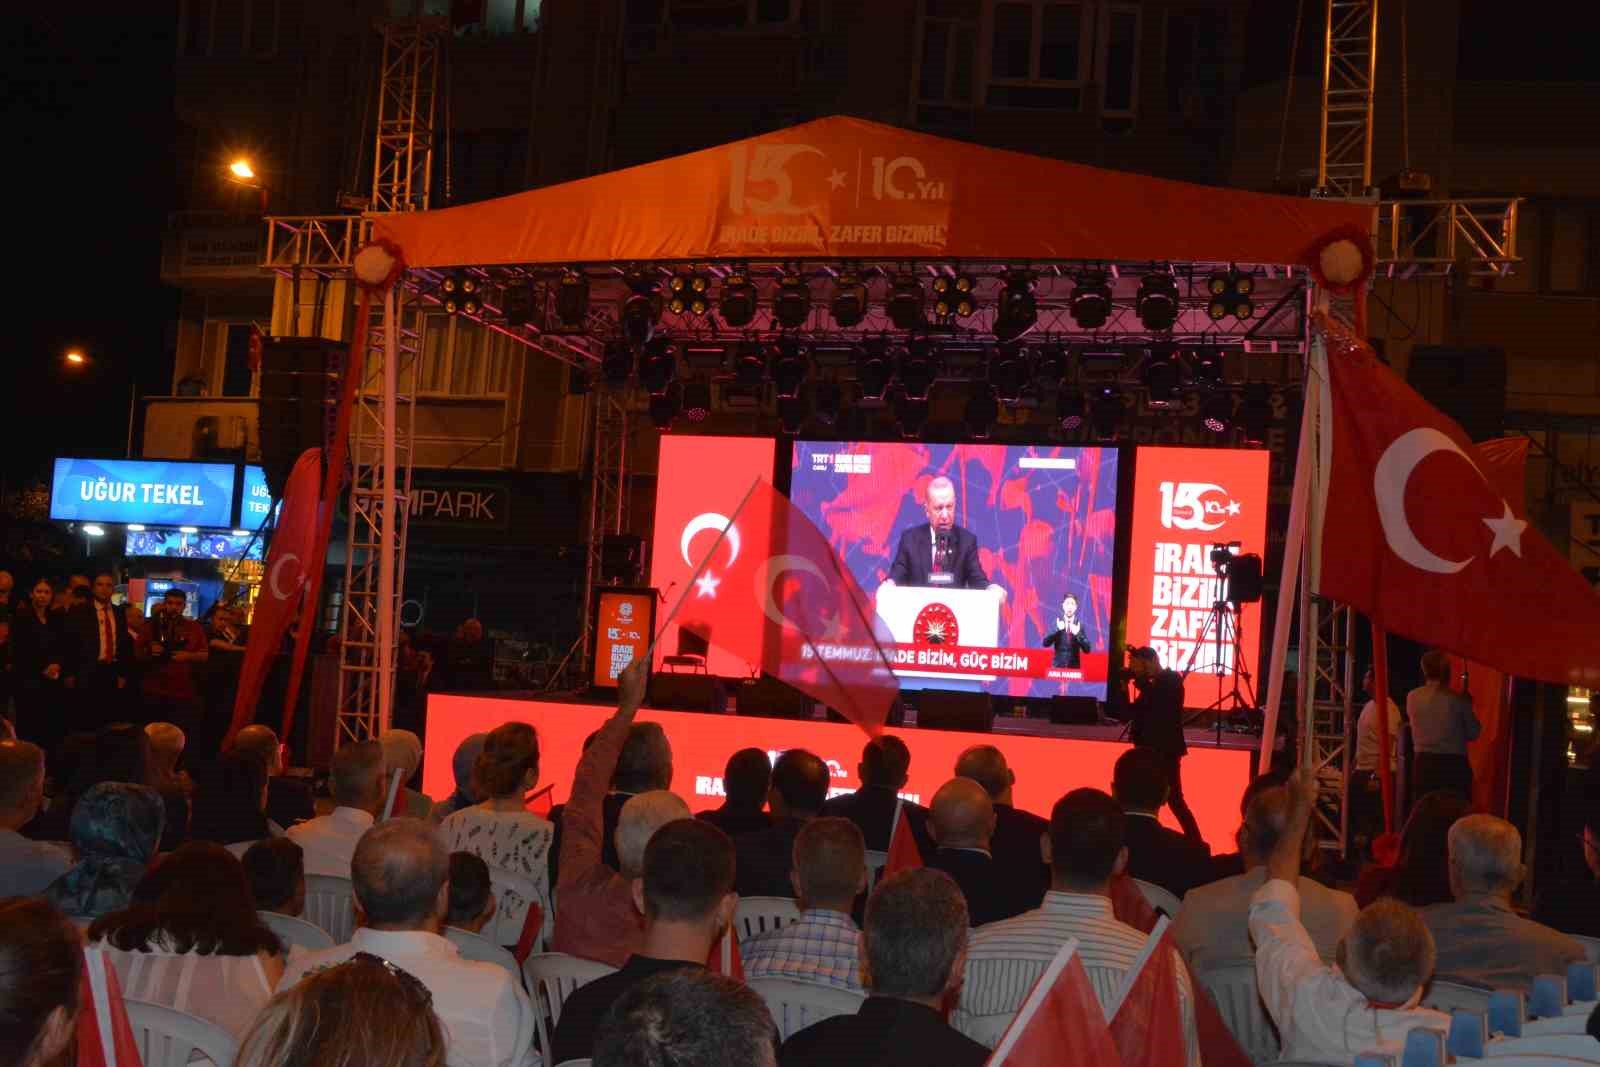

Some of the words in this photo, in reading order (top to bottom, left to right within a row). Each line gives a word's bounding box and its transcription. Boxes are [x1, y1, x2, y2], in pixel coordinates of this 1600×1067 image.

[730, 143, 800, 216] 15
[830, 224, 882, 243] ZAFER
[80, 477, 136, 503] UĞUR
[140, 483, 204, 506] TEKEL
[249, 501, 270, 514] TEK
[1160, 481, 1210, 531] 15
[918, 649, 957, 668] BİZİM,
[960, 650, 988, 669] GÜÇ
[991, 653, 1028, 671] BİZİM
